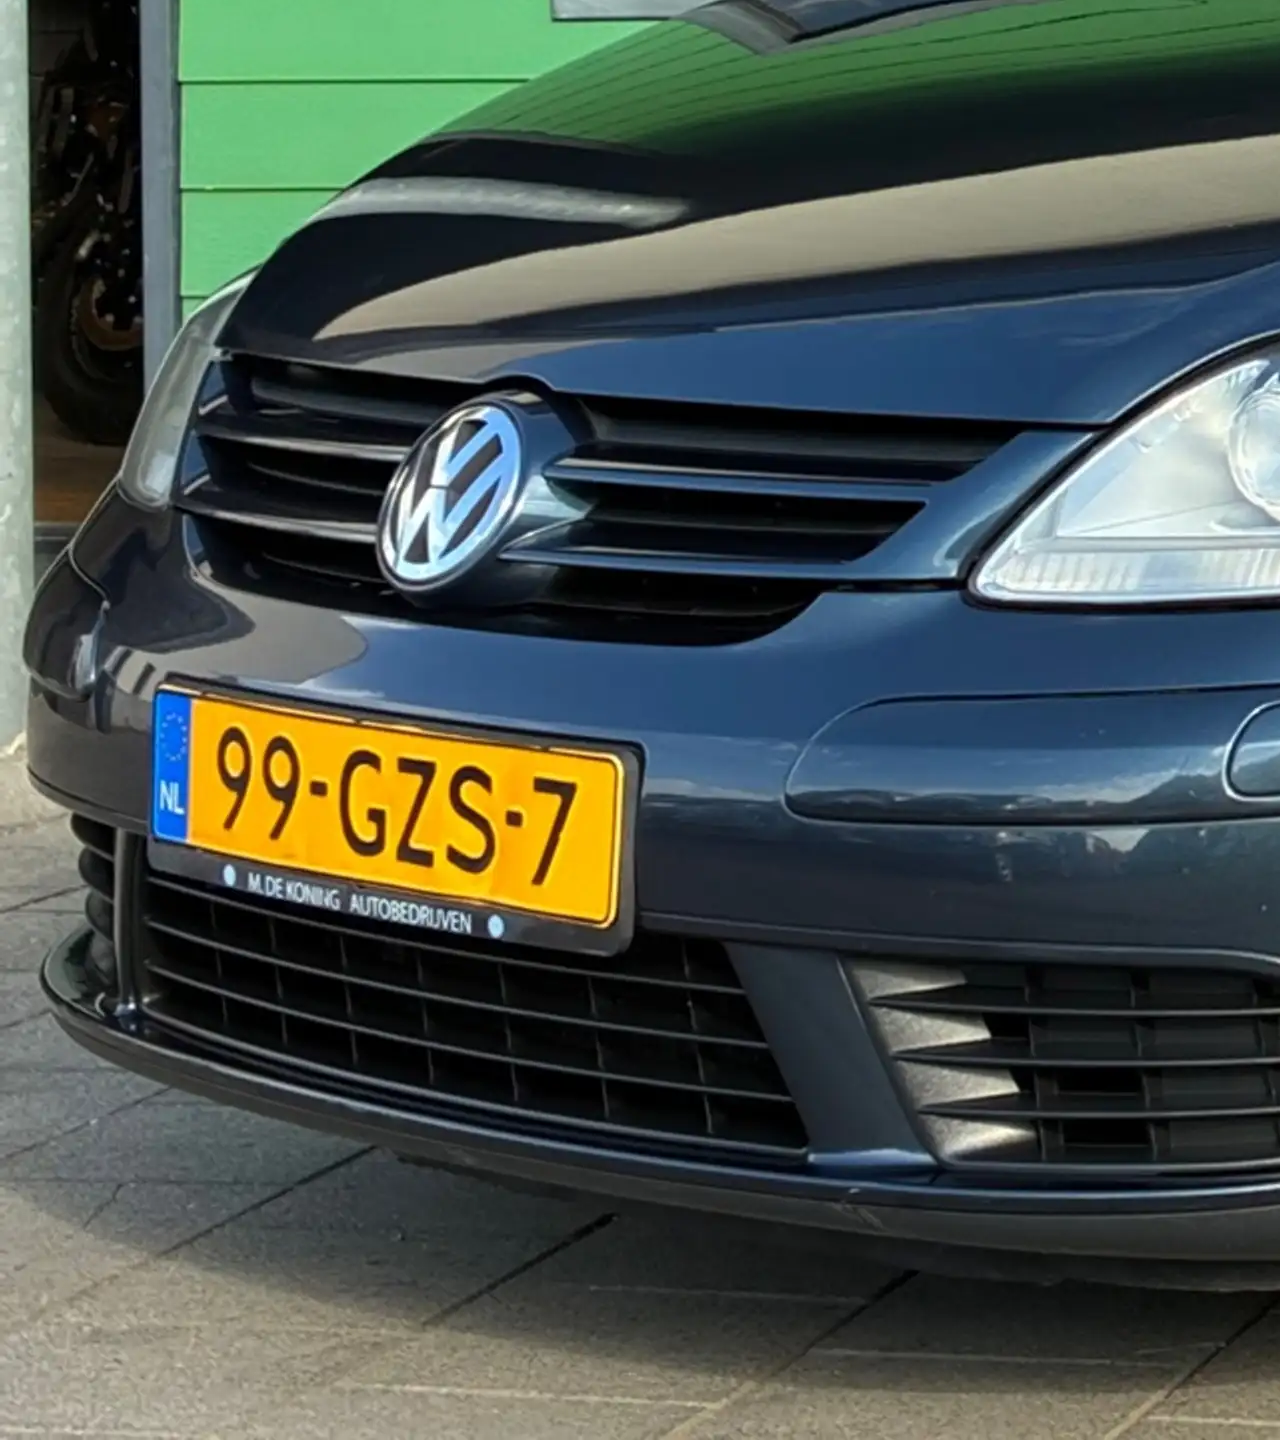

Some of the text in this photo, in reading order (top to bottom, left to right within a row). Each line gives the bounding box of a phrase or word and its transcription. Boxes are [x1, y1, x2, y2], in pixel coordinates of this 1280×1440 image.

[160, 779, 185, 815] NL
[217, 725, 578, 887] 99-GZS-7
[286, 880, 341, 911] KONING
[350, 894, 472, 934] AUTOBEDRIJVEN
